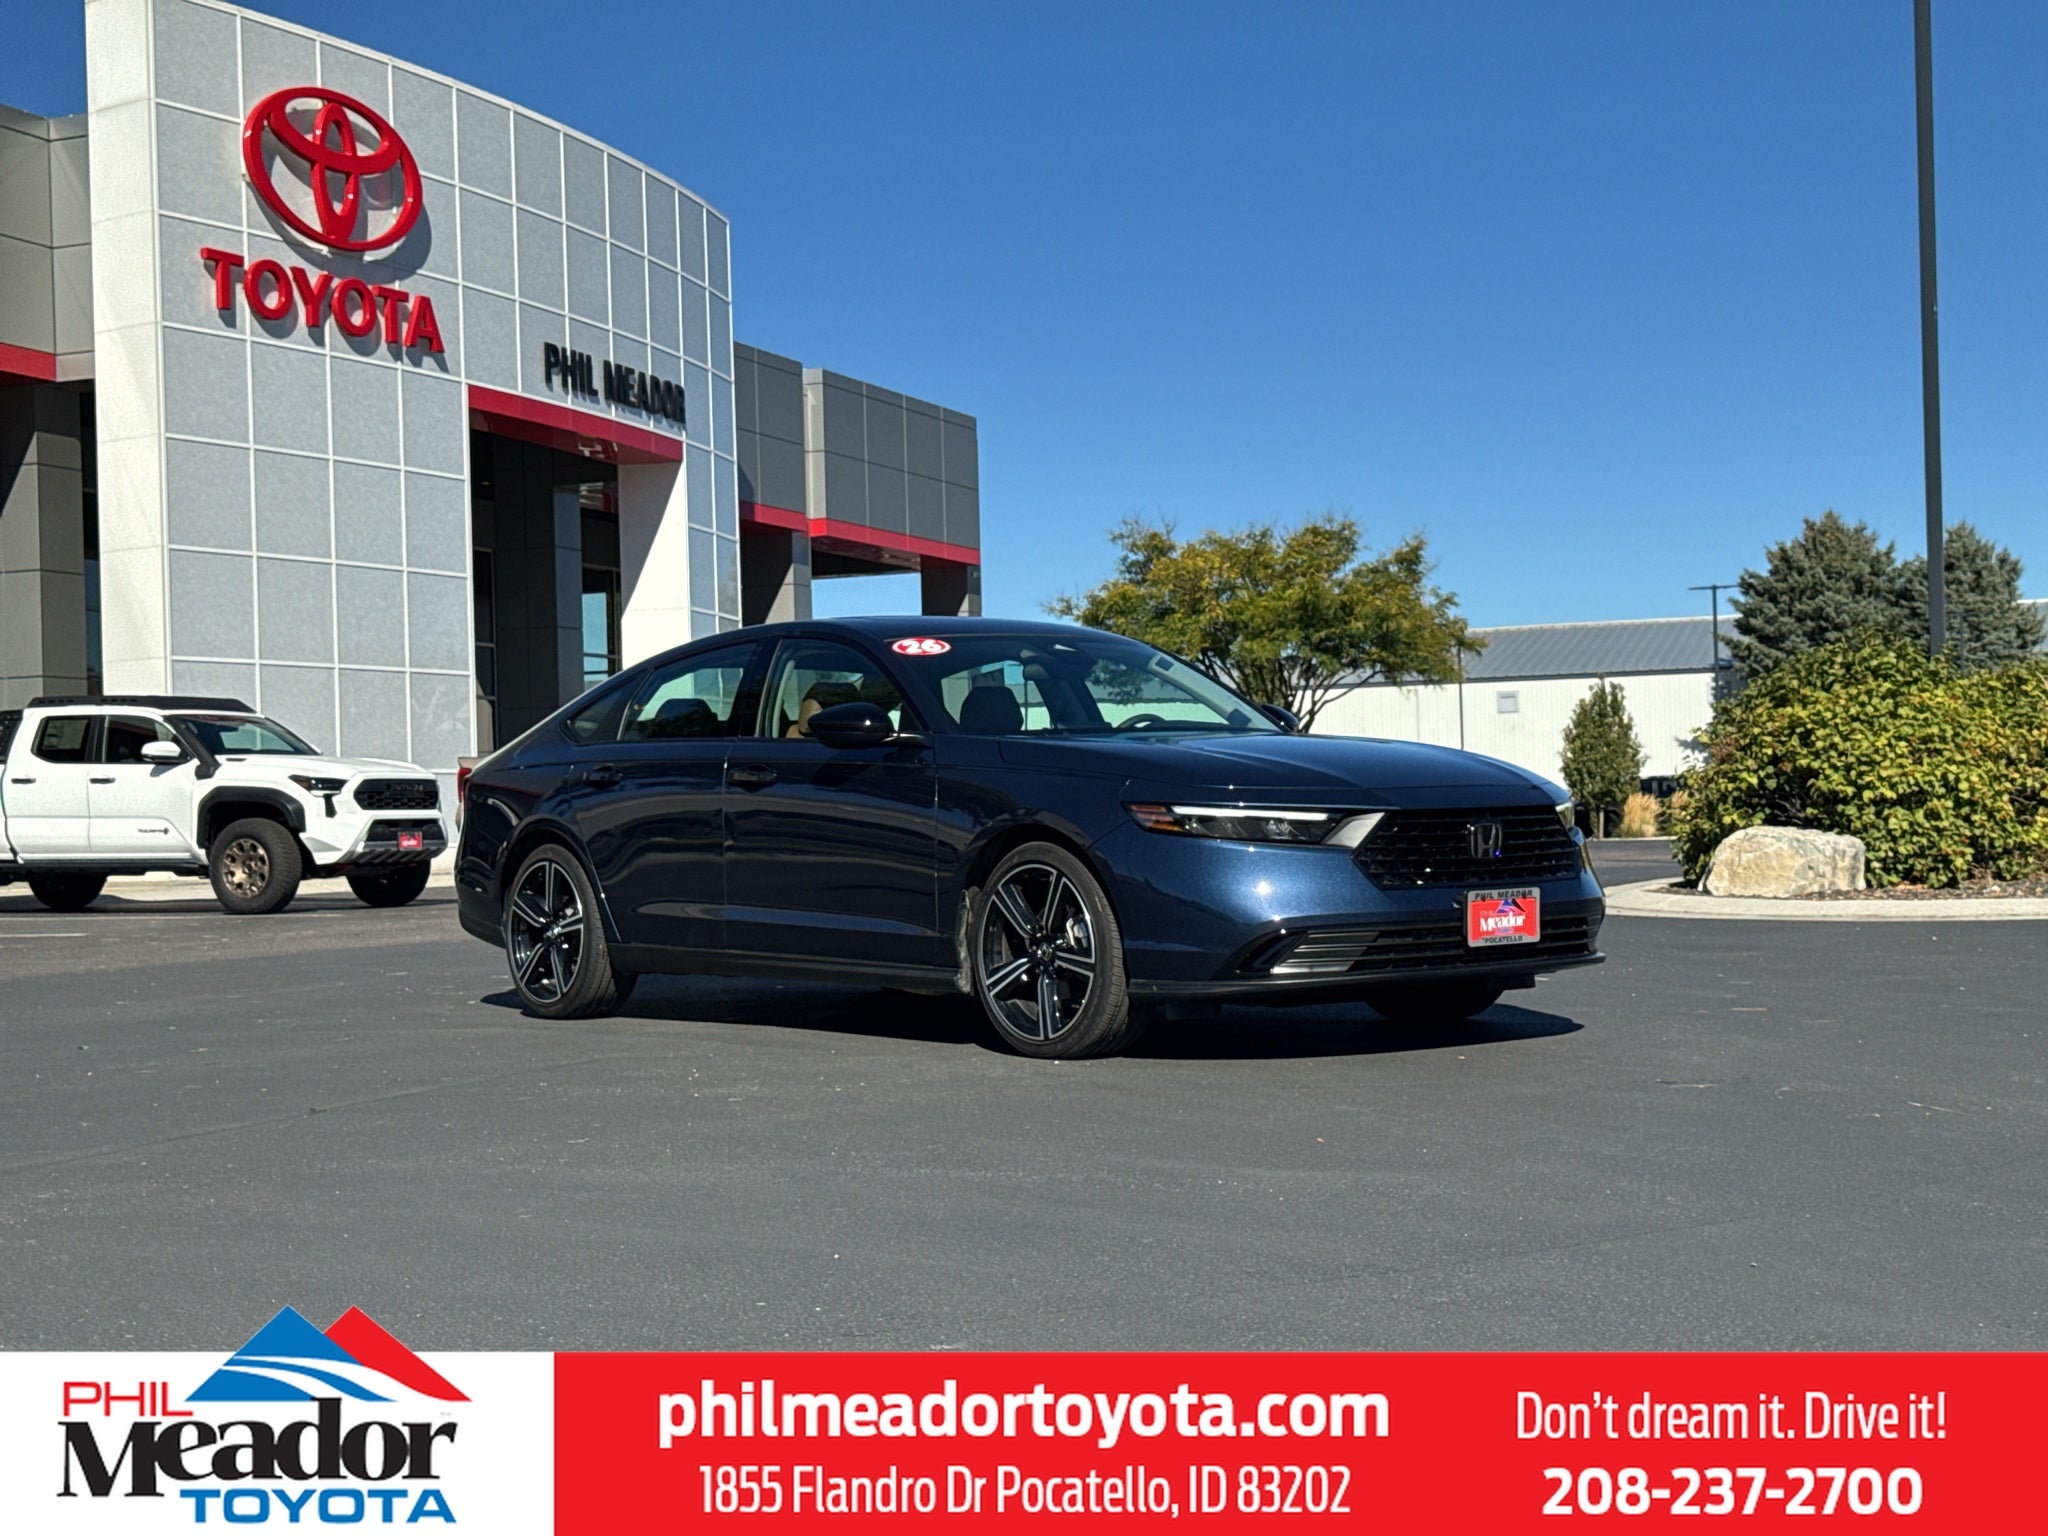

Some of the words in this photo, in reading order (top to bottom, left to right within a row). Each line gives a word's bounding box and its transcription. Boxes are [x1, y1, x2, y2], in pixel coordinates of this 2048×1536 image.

[201, 247, 445, 353] TOYOTA
[544, 342, 599, 397] PHIL
[603, 359, 686, 424] MEADOR
[897, 639, 942, 653] 26
[1498, 890, 1533, 898] MEADOR
